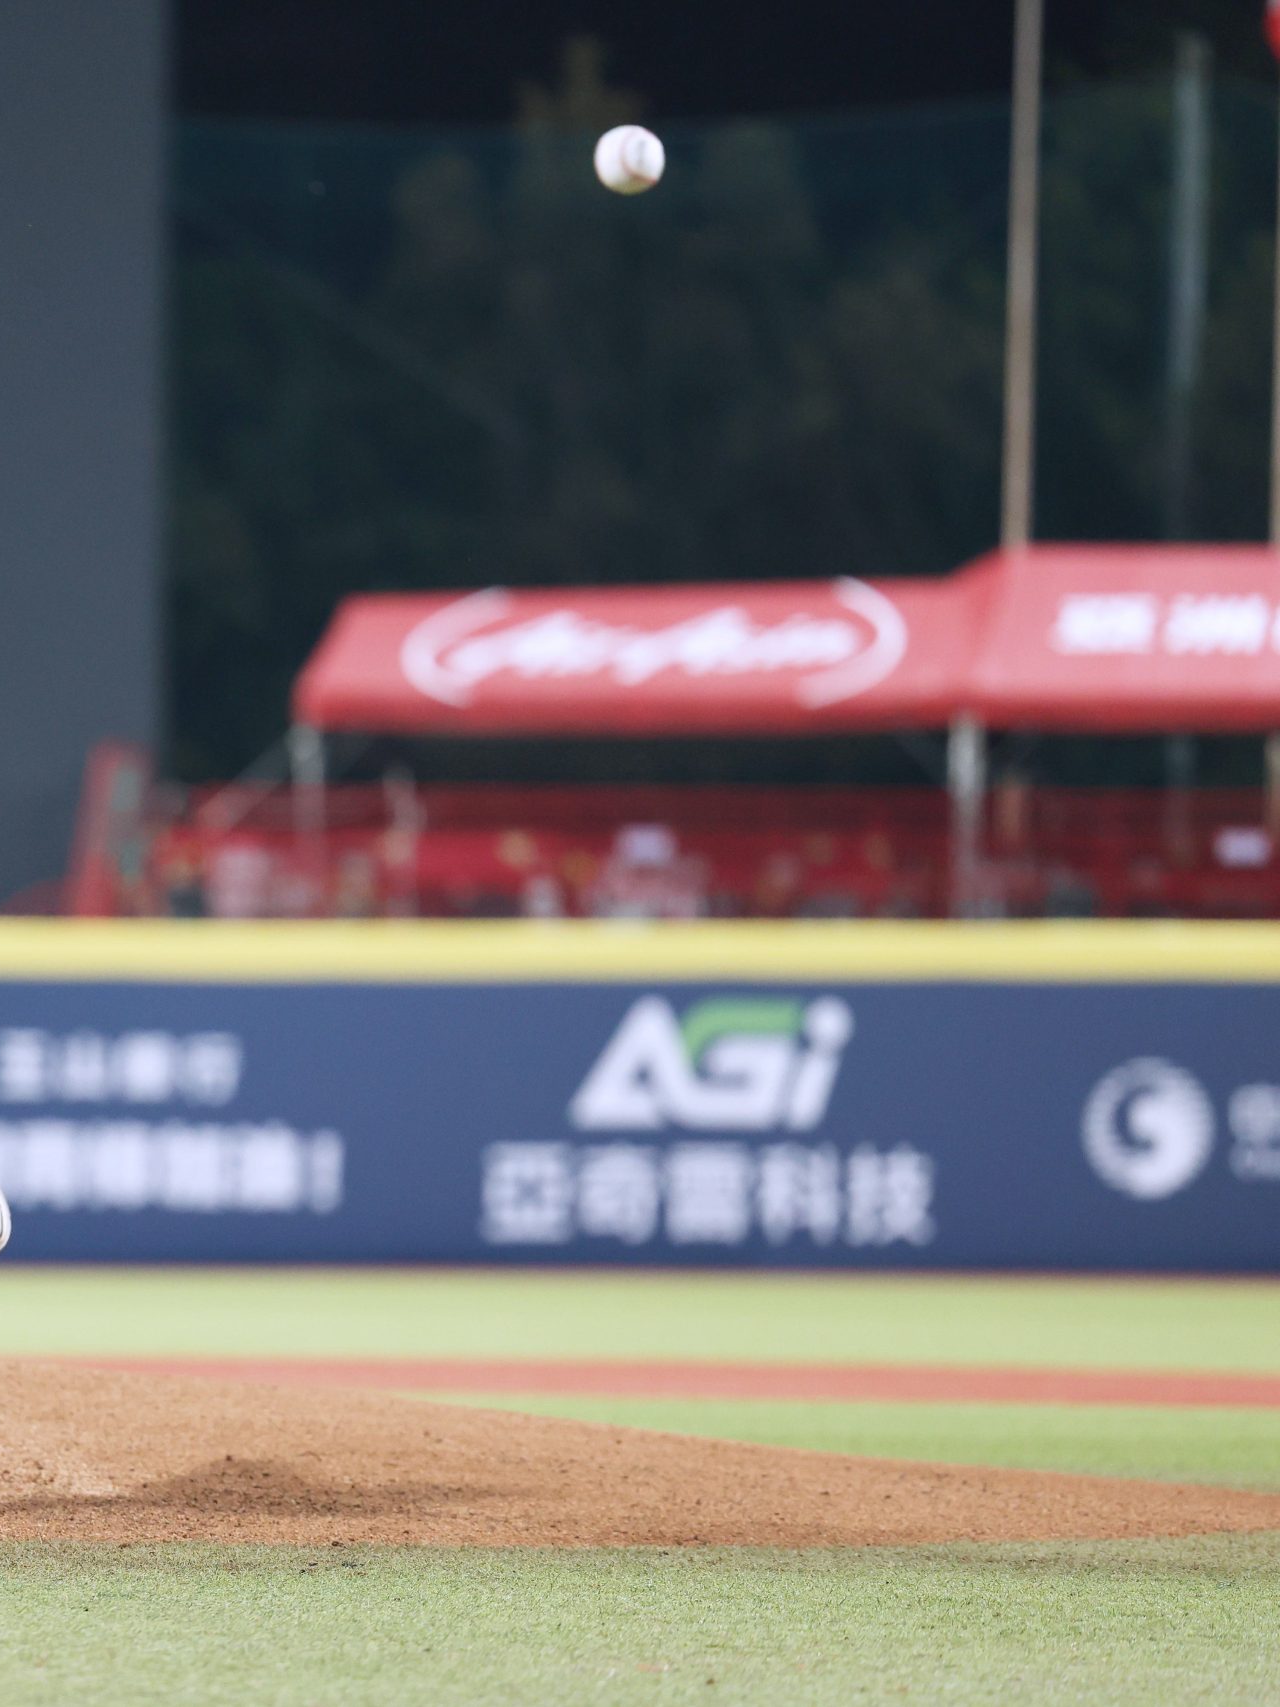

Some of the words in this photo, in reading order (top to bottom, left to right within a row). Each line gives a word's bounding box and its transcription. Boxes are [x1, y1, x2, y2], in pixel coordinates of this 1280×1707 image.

[482, 1142, 934, 1244] 亞奇雷科技
